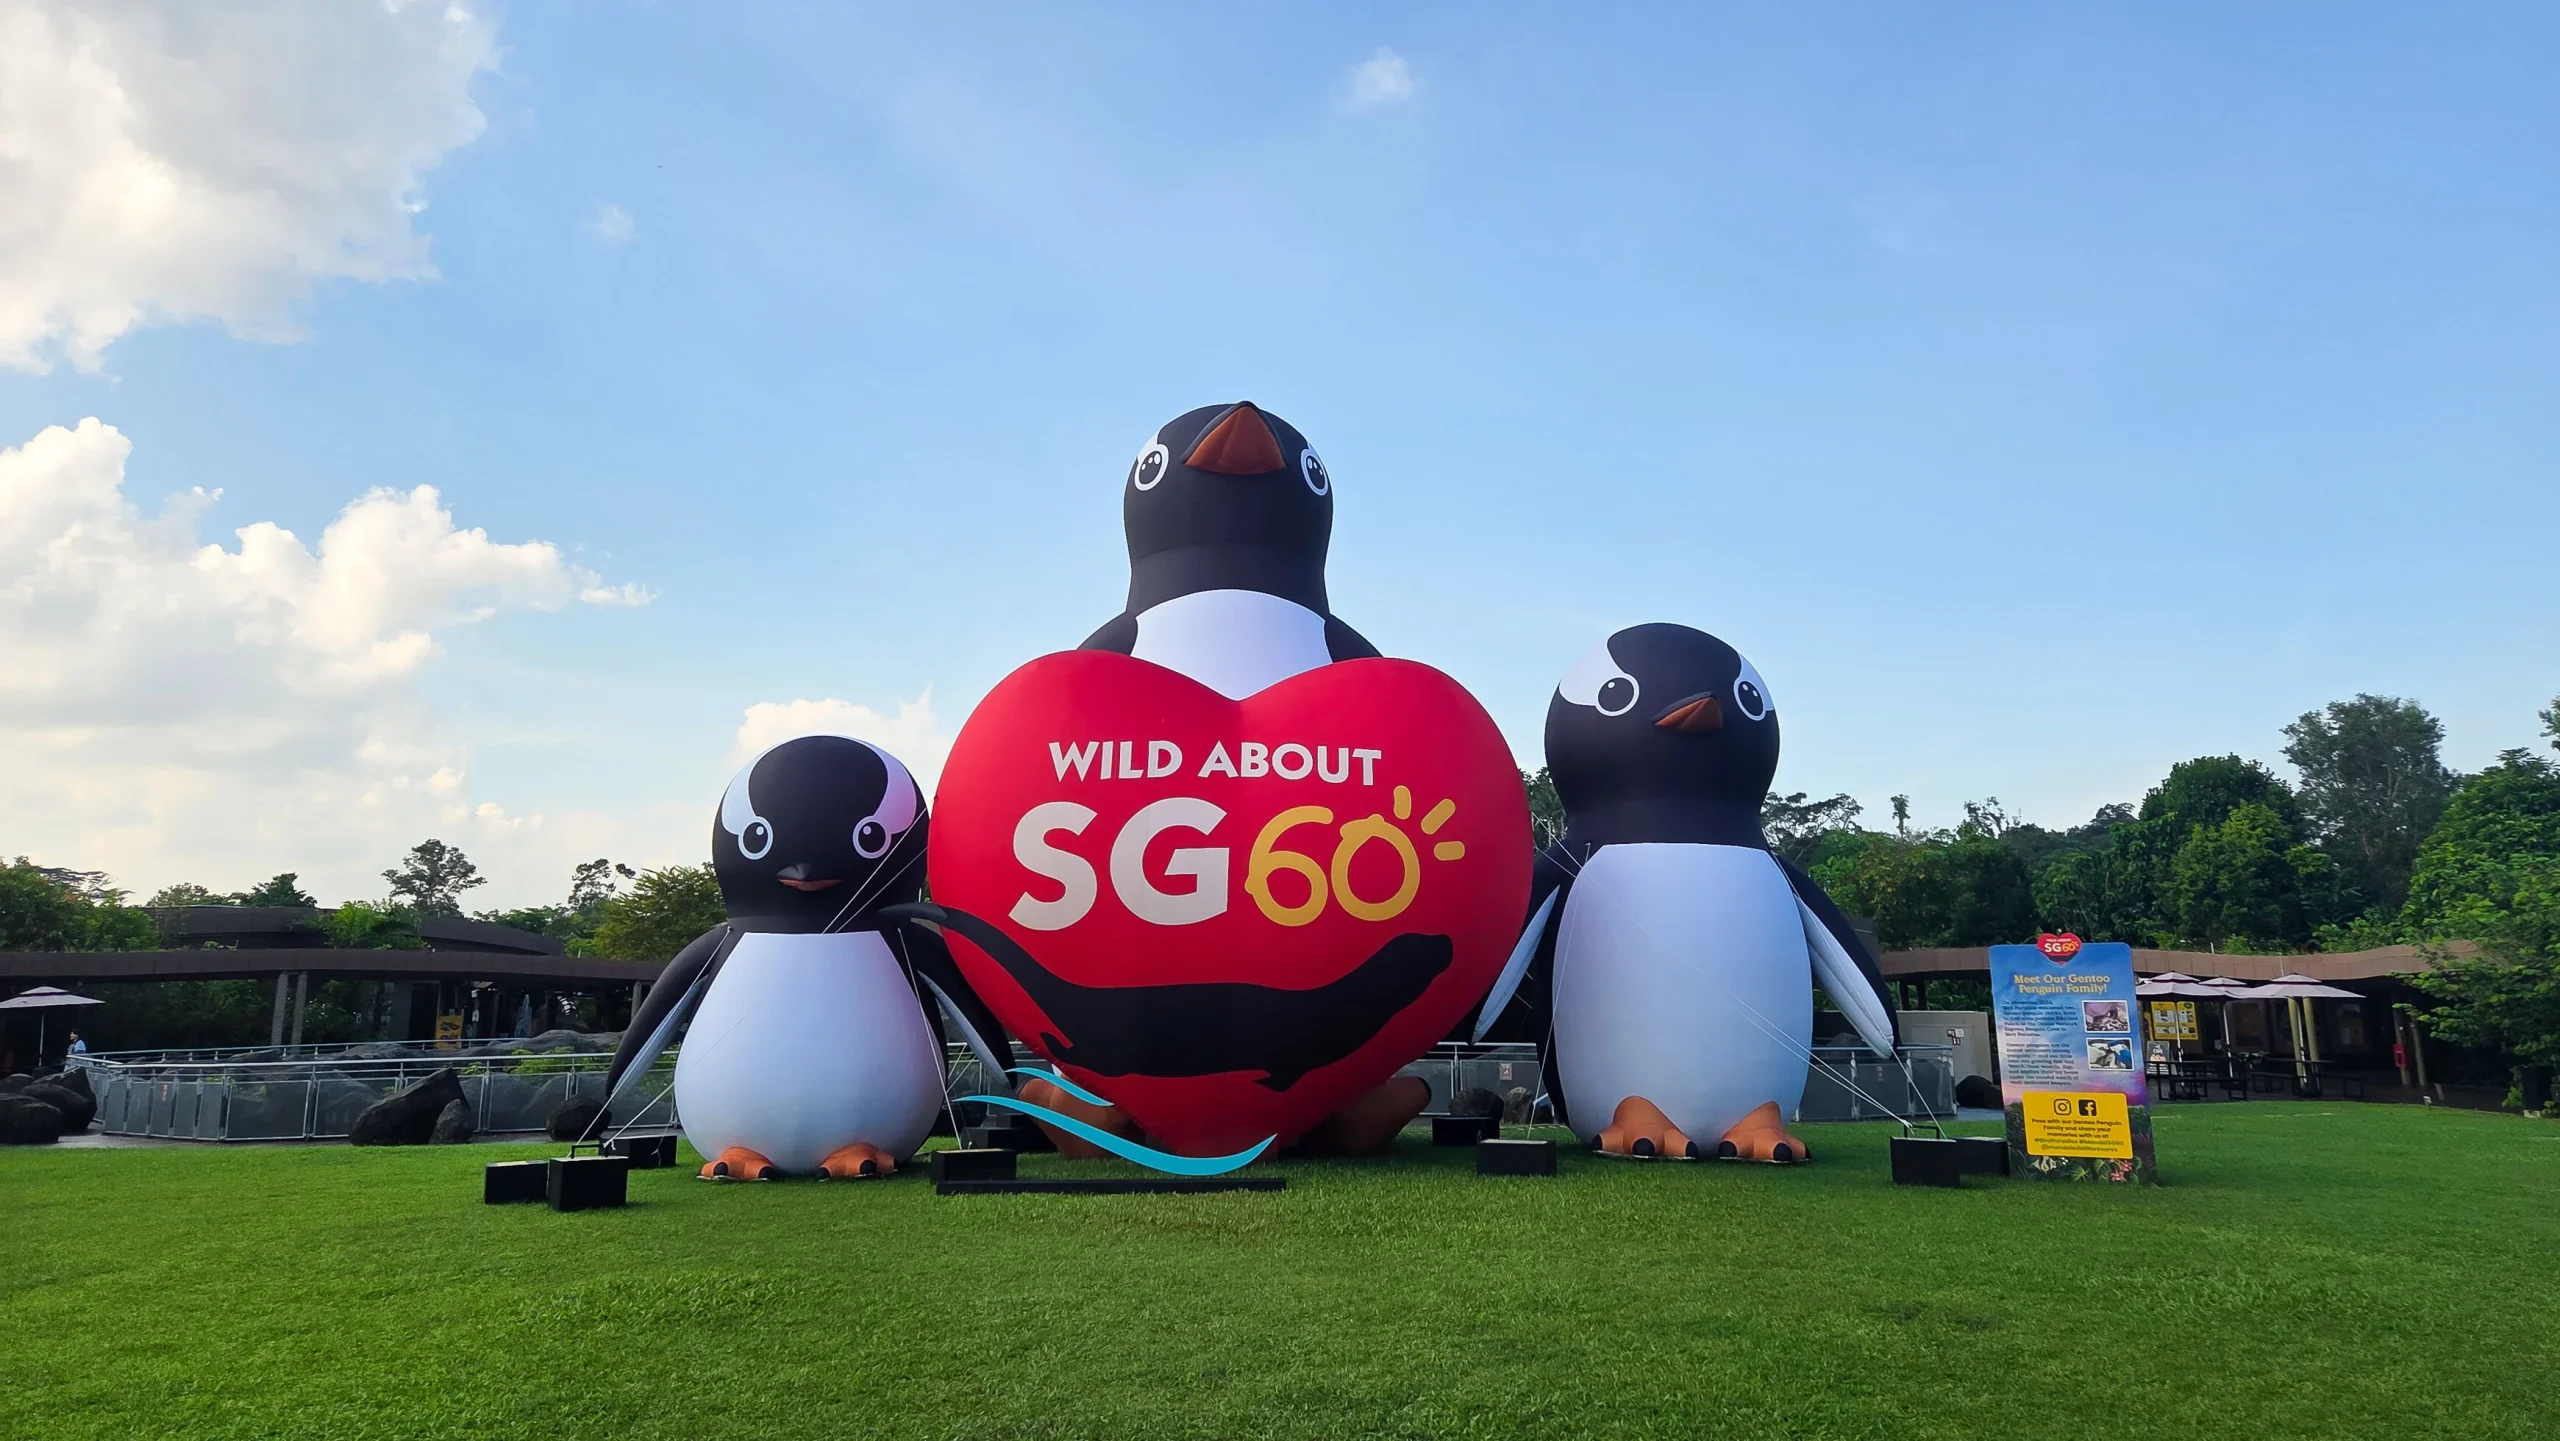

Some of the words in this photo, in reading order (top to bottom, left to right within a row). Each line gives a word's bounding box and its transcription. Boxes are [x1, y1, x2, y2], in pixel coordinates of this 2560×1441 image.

[1048, 740, 1183, 782] WILD
[1197, 740, 1382, 786] ABOUT
[1008, 796, 1421, 931] SG60
[2044, 942, 2077, 952] SG60
[2014, 974, 2040, 984] Meet
[2044, 974, 2065, 984] Our
[2068, 973, 2110, 983] Gentoo
[2019, 984, 2063, 996] Penguin
[2066, 983, 2108, 995] Family!
